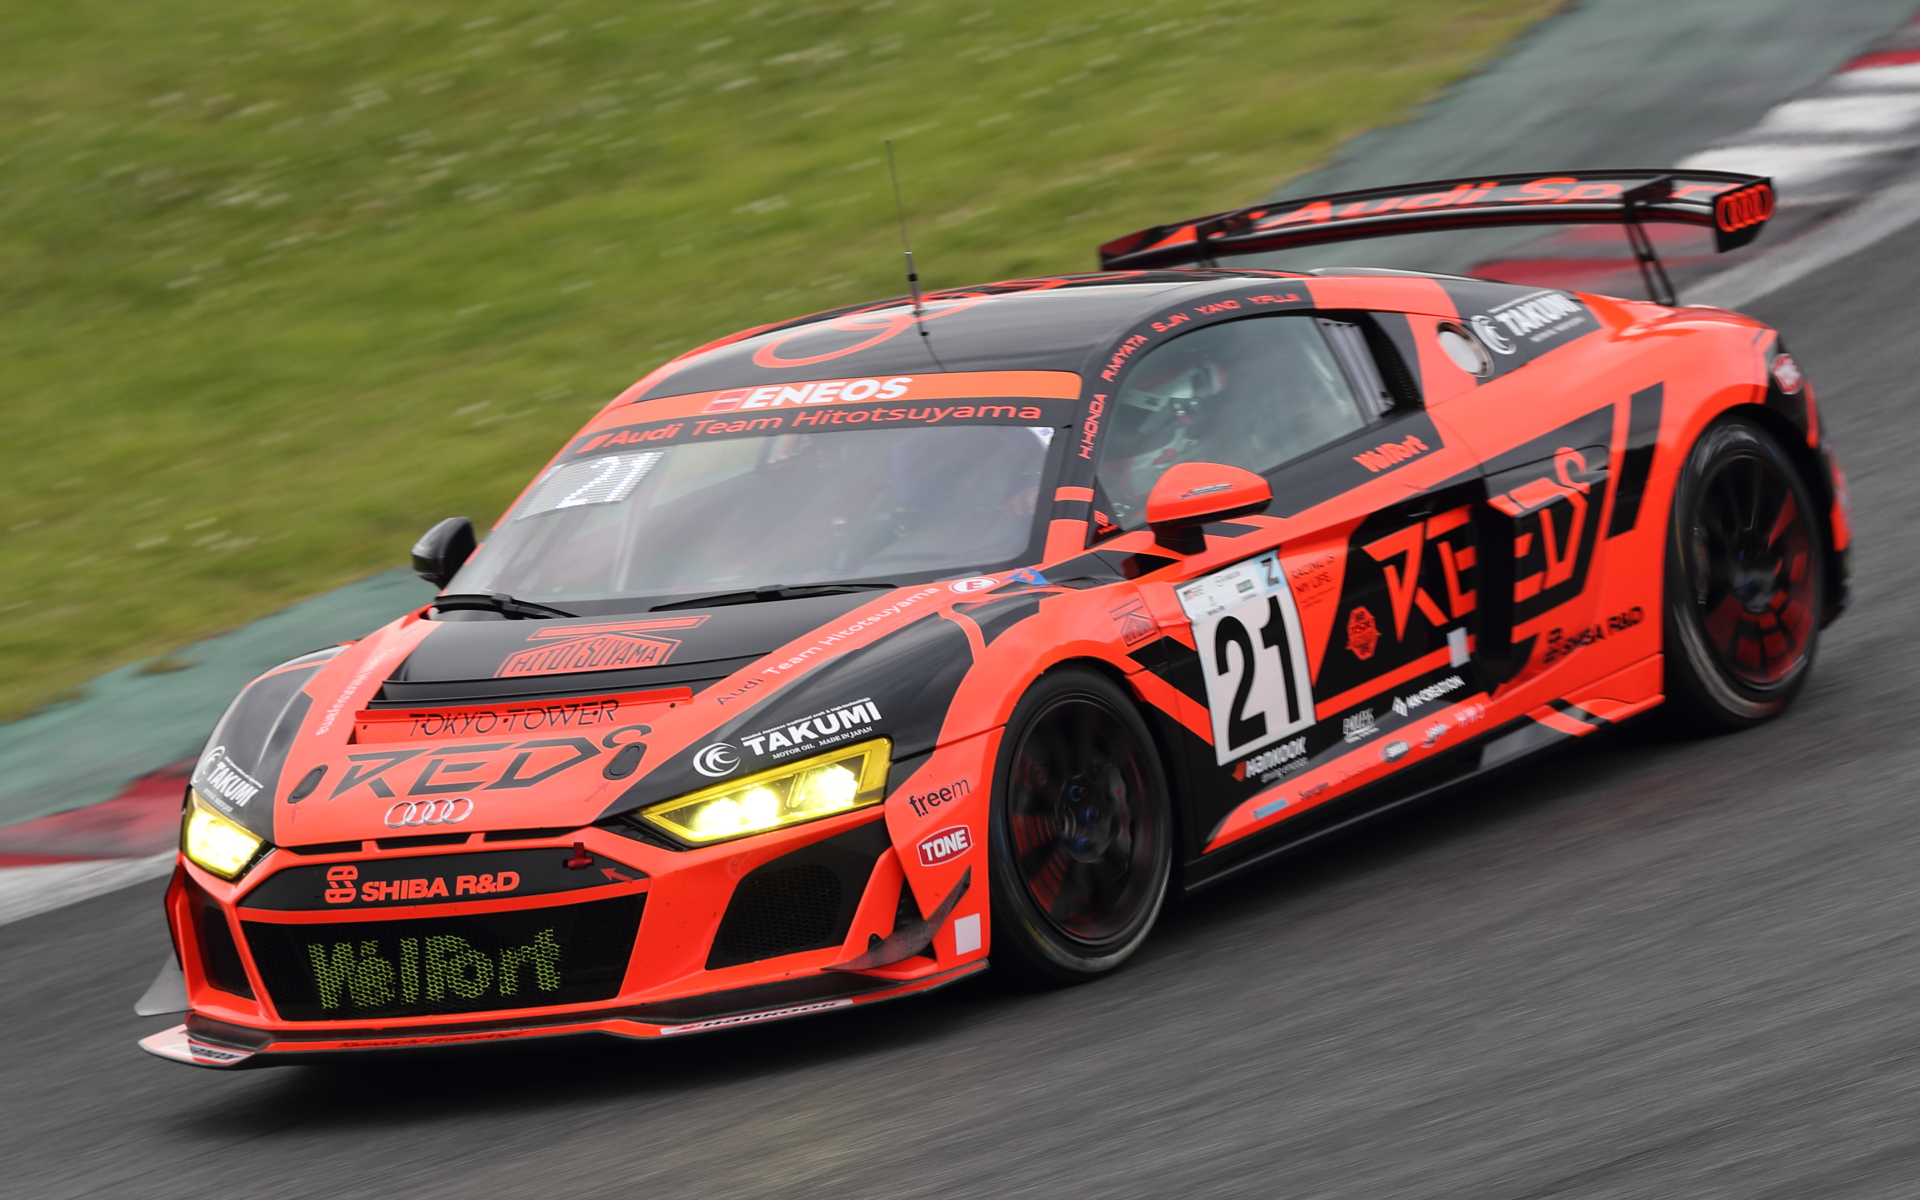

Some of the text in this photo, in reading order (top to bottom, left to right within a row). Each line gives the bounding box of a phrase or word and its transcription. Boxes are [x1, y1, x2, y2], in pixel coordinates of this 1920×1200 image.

[1252, 182, 1499, 230] Audi
[739, 377, 913, 410] ENEOS
[602, 404, 1042, 447] Audi Team Hitotsuyama
[1078, 394, 1108, 460] H.HONDA
[556, 452, 654, 509] 21
[510, 637, 660, 673] HITOTSUYAMA
[716, 586, 941, 706] Audi Team Hitotsuyama
[1215, 595, 1301, 751] 21
[409, 699, 619, 737] TOKYO TOWER
[743, 701, 882, 756] TAKUMI
[772, 726, 873, 760] MOTOR OIL MADE IN JAPAN
[207, 761, 259, 807] TAKUMI
[909, 778, 971, 817] freem
[921, 828, 968, 862] TONE
[361, 871, 520, 901] SHIBA R&D
